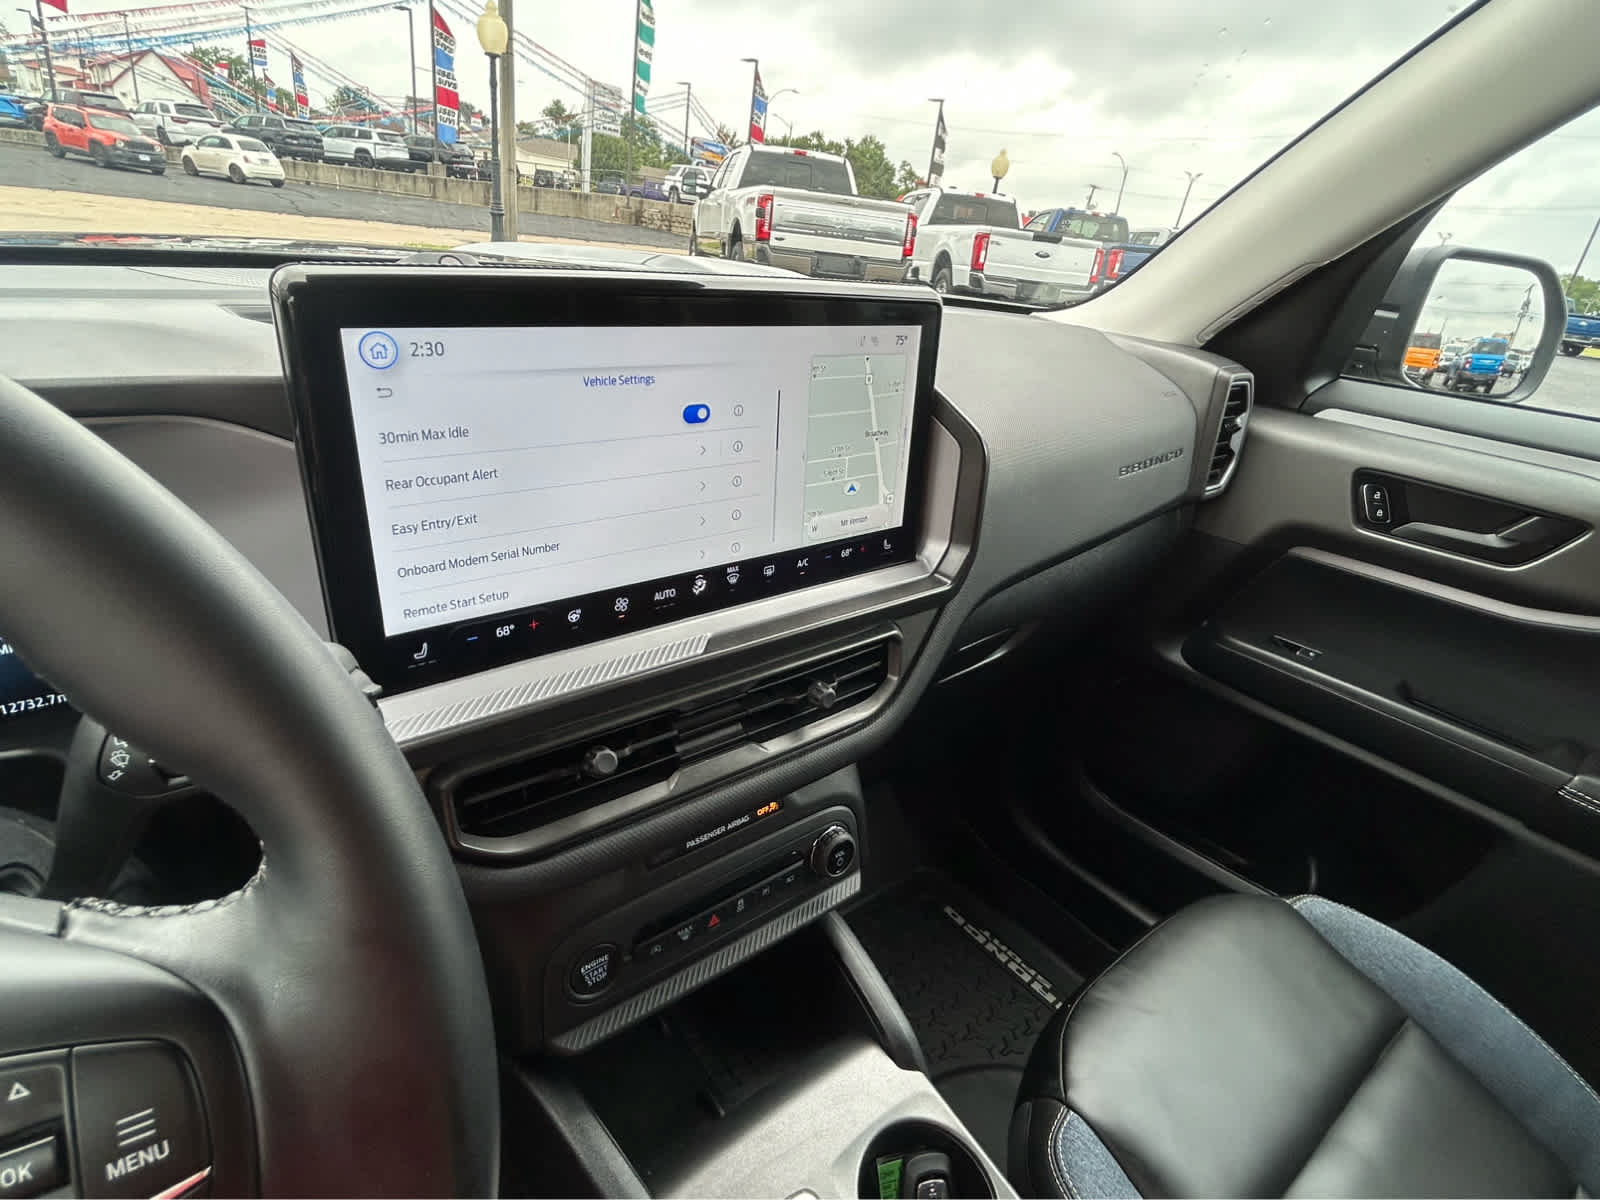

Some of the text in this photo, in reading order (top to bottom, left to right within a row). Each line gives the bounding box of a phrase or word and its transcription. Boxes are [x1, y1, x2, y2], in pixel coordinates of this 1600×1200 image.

[410, 341, 445, 358] 2:30
[583, 373, 656, 387] Vehicle Settings
[378, 425, 470, 445] 30min Max Idle
[1119, 448, 1184, 479] BRONCO
[385, 468, 499, 491] Rear Occupant Alert
[391, 513, 479, 536] Easy Entry/Exit
[397, 540, 561, 579] Onboard Modem Serial Number
[727, 566, 740, 574] MAX
[797, 558, 809, 569] A/C
[403, 590, 510, 620] Remote Start Setup
[653, 588, 676, 602] AUTO
[495, 623, 515, 638] 68°
[685, 803, 770, 849] PASSENGER AIRBAG OFF
[580, 953, 609, 975] ENGINE
[943, 905, 1062, 1010] RONCO
[584, 963, 608, 981] START
[587, 972, 608, 987] STOP
[104, 1140, 170, 1181] MENU
[0, 1162, 33, 1188] OK
